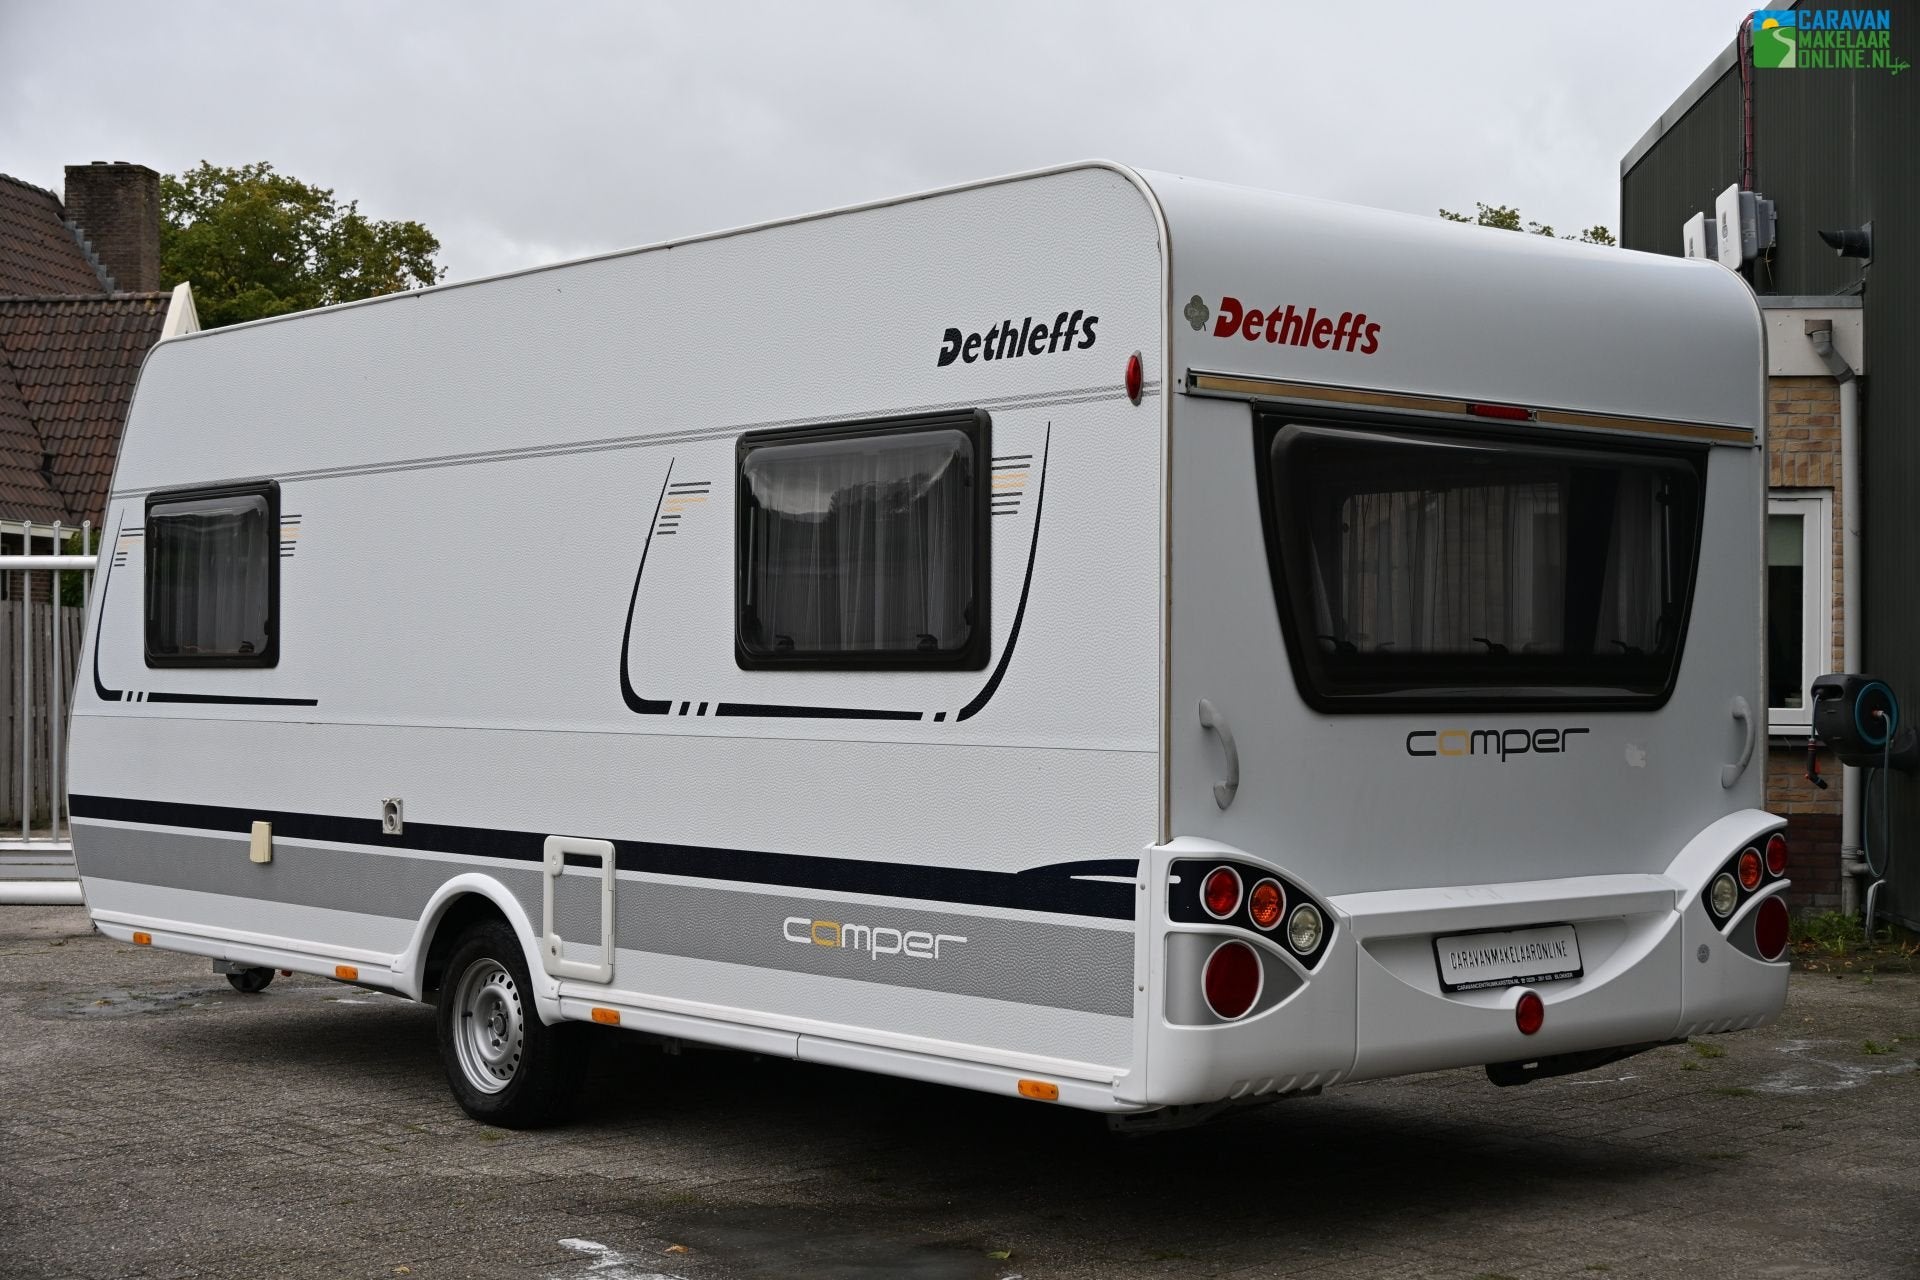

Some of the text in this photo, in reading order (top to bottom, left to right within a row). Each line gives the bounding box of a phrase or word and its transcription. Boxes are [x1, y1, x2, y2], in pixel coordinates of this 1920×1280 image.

[937, 309, 1099, 367] Dethleffs
[1213, 296, 1381, 355] Dethleffs
[1406, 727, 1590, 763] camper
[783, 916, 968, 961] camper
[1450, 940, 1568, 970] CARAVANMAKELAARONLINE
